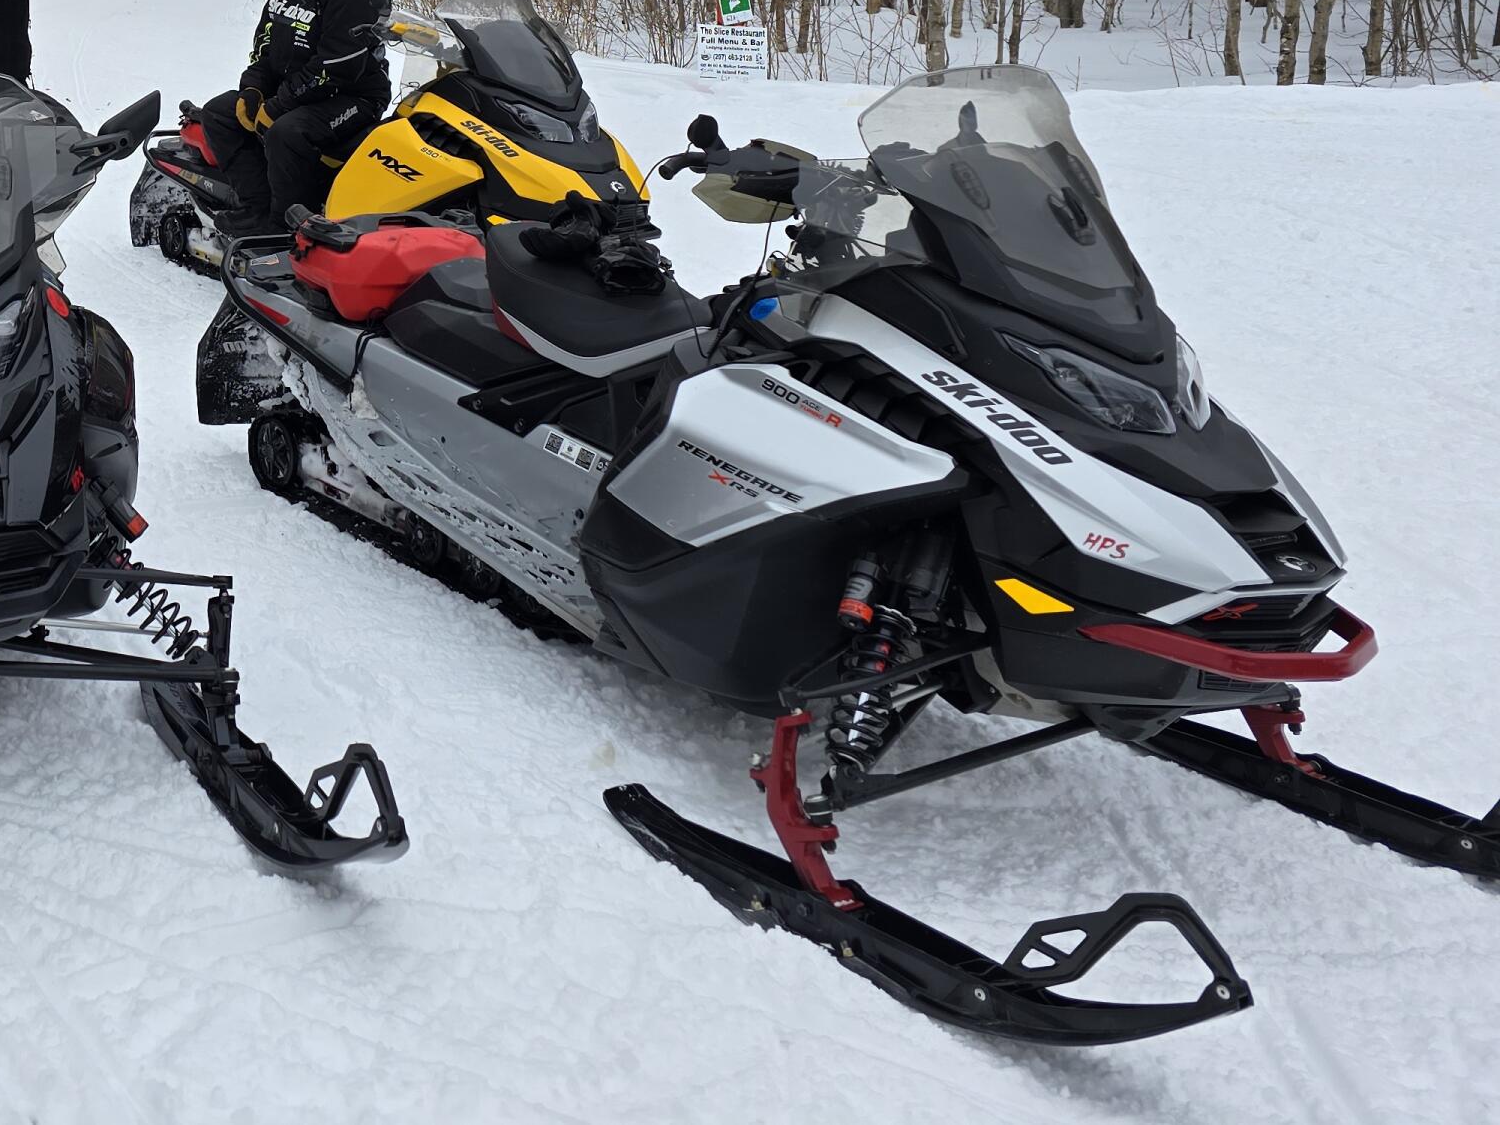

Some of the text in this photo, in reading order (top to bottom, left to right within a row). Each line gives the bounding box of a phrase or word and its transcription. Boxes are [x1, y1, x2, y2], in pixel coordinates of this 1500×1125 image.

[700, 26, 766, 37] The Slice Restaurant
[701, 36, 716, 44] Full
[718, 37, 739, 45] Menu
[459, 119, 520, 158] ski-doo
[368, 148, 425, 182] MXZ
[761, 378, 822, 413] 900 ACE
[825, 412, 843, 428] R
[921, 370, 1074, 465] ski-doo
[677, 439, 805, 503] RENEGADE
[728, 480, 761, 499] RS
[1082, 531, 1130, 559] HPS
